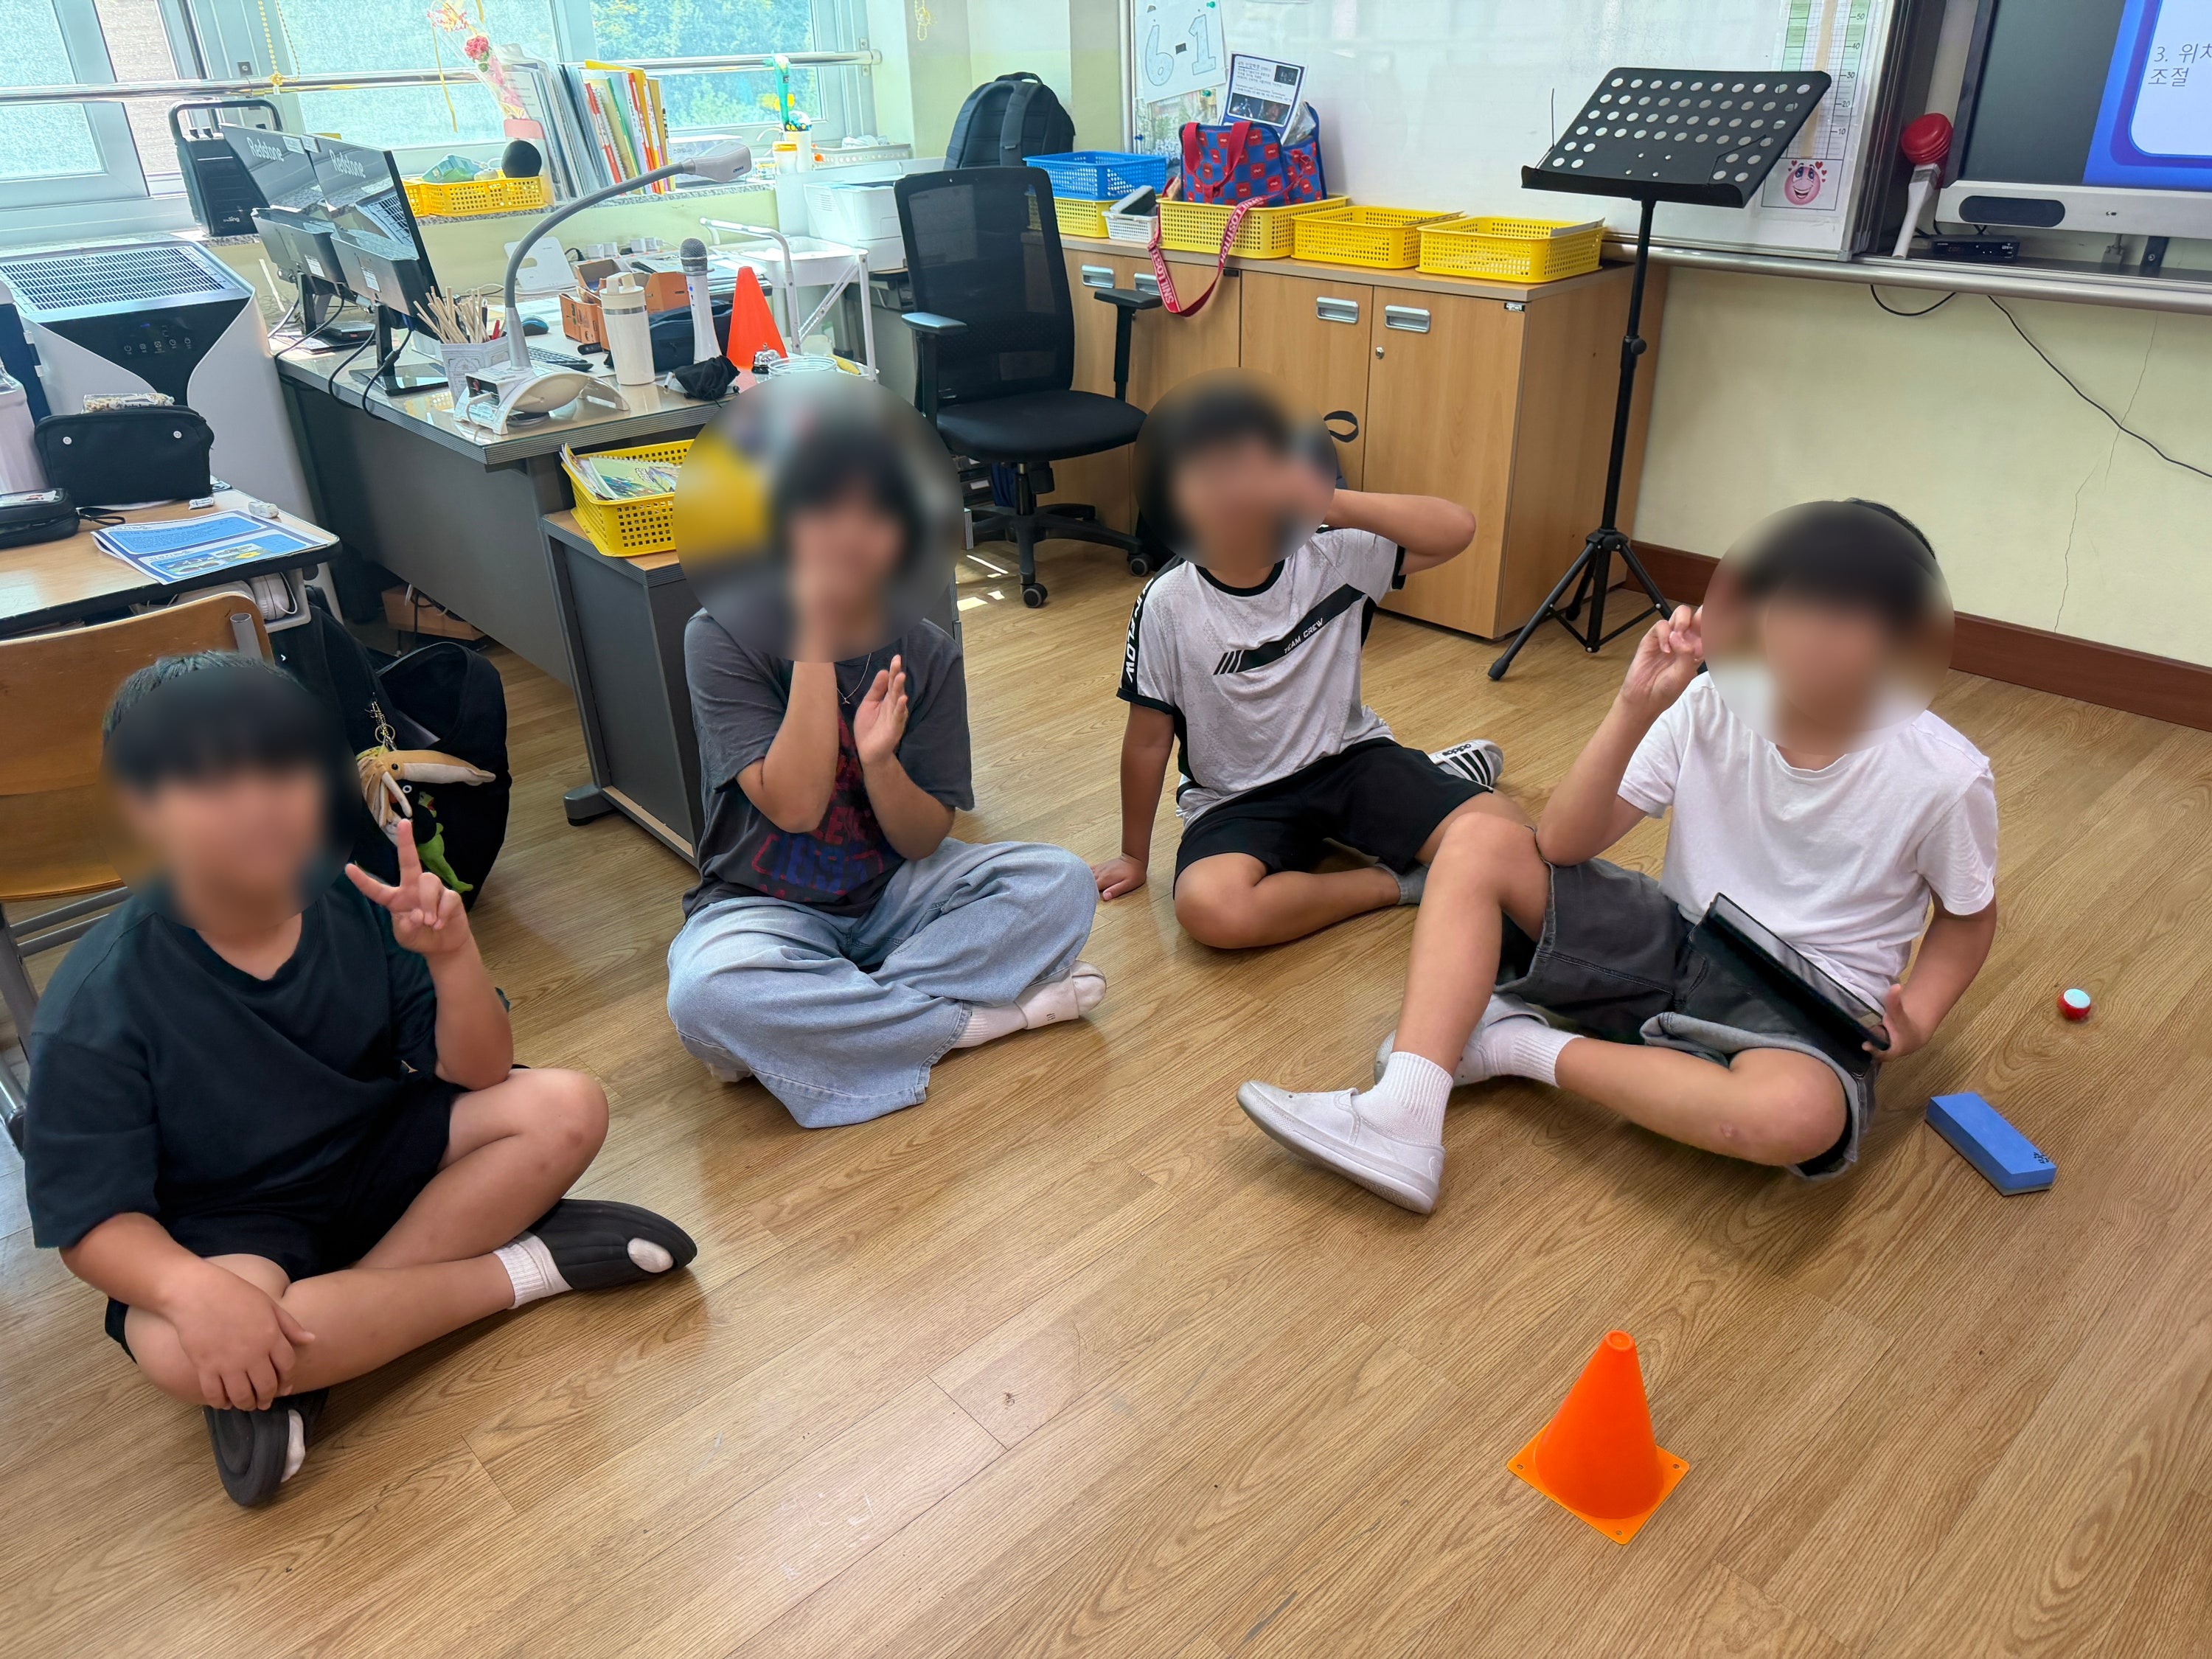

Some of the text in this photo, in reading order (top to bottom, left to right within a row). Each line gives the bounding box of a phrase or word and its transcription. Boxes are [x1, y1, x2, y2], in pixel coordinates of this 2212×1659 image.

[1145, 14, 1217, 86] 6-1
[2154, 46, 2168, 62] 3.
[2148, 68, 2189, 87] 조절
[246, 136, 285, 162] Redstone
[329, 149, 366, 178] Redstone
[1284, 617, 1324, 654] TEAM CREW
[1125, 617, 1136, 684] FLOW
